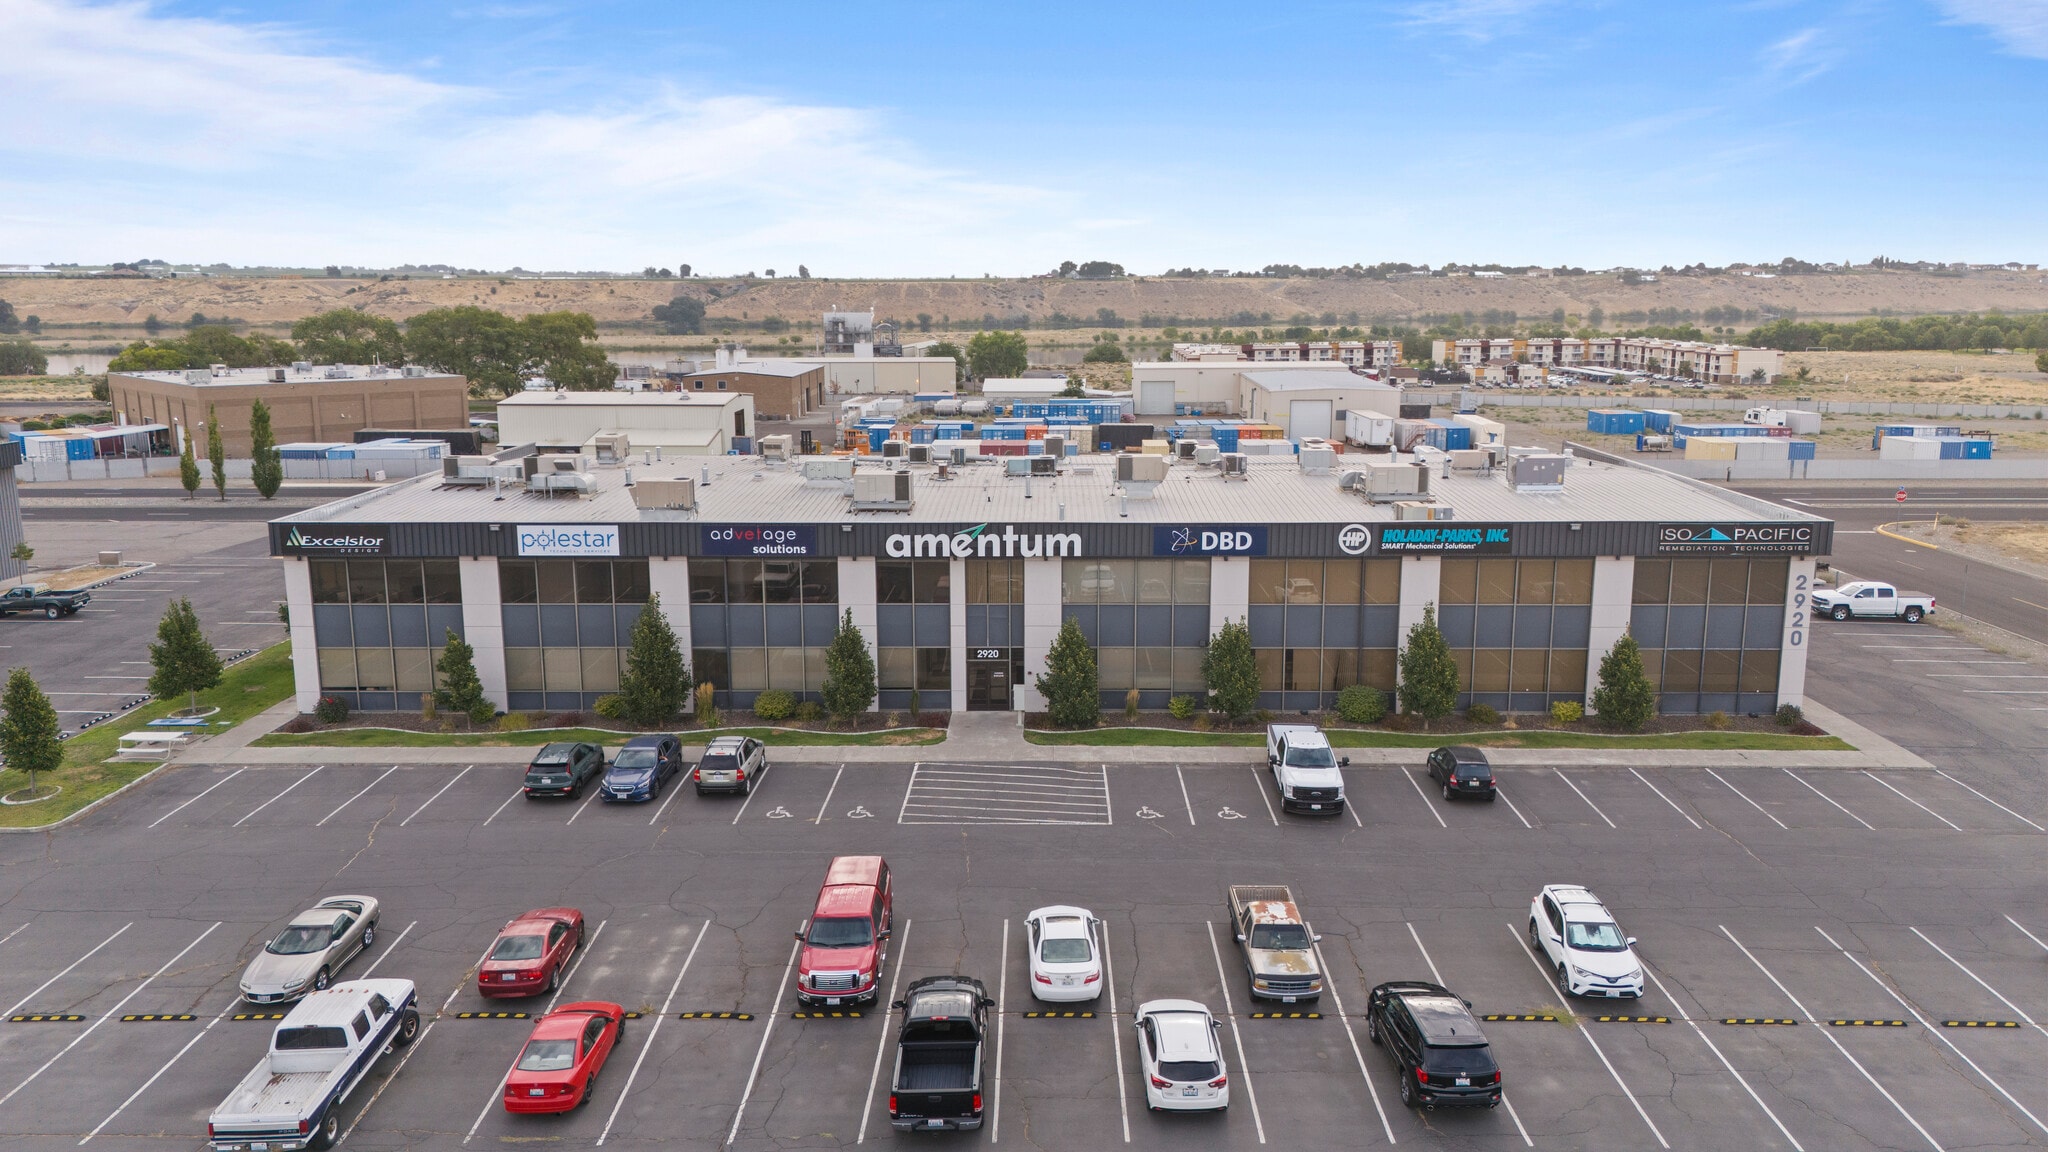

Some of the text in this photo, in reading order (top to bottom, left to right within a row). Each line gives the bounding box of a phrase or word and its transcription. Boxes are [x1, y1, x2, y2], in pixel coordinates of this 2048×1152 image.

[301, 535, 384, 546] Excelsior
[521, 528, 615, 553] polestar
[710, 527, 797, 543] advetage
[885, 524, 1082, 558] amentum
[1201, 531, 1253, 551] DBD
[1382, 528, 1510, 545] HOLADAY-PARKS, INC.
[1660, 528, 1811, 541] ISO PACIFIC
[752, 544, 807, 554] solutions
[1381, 542, 1405, 550] SMART
[1405, 542, 1444, 550] Mechanical
[1790, 574, 1808, 647] 2920
[976, 649, 999, 658] 2920
